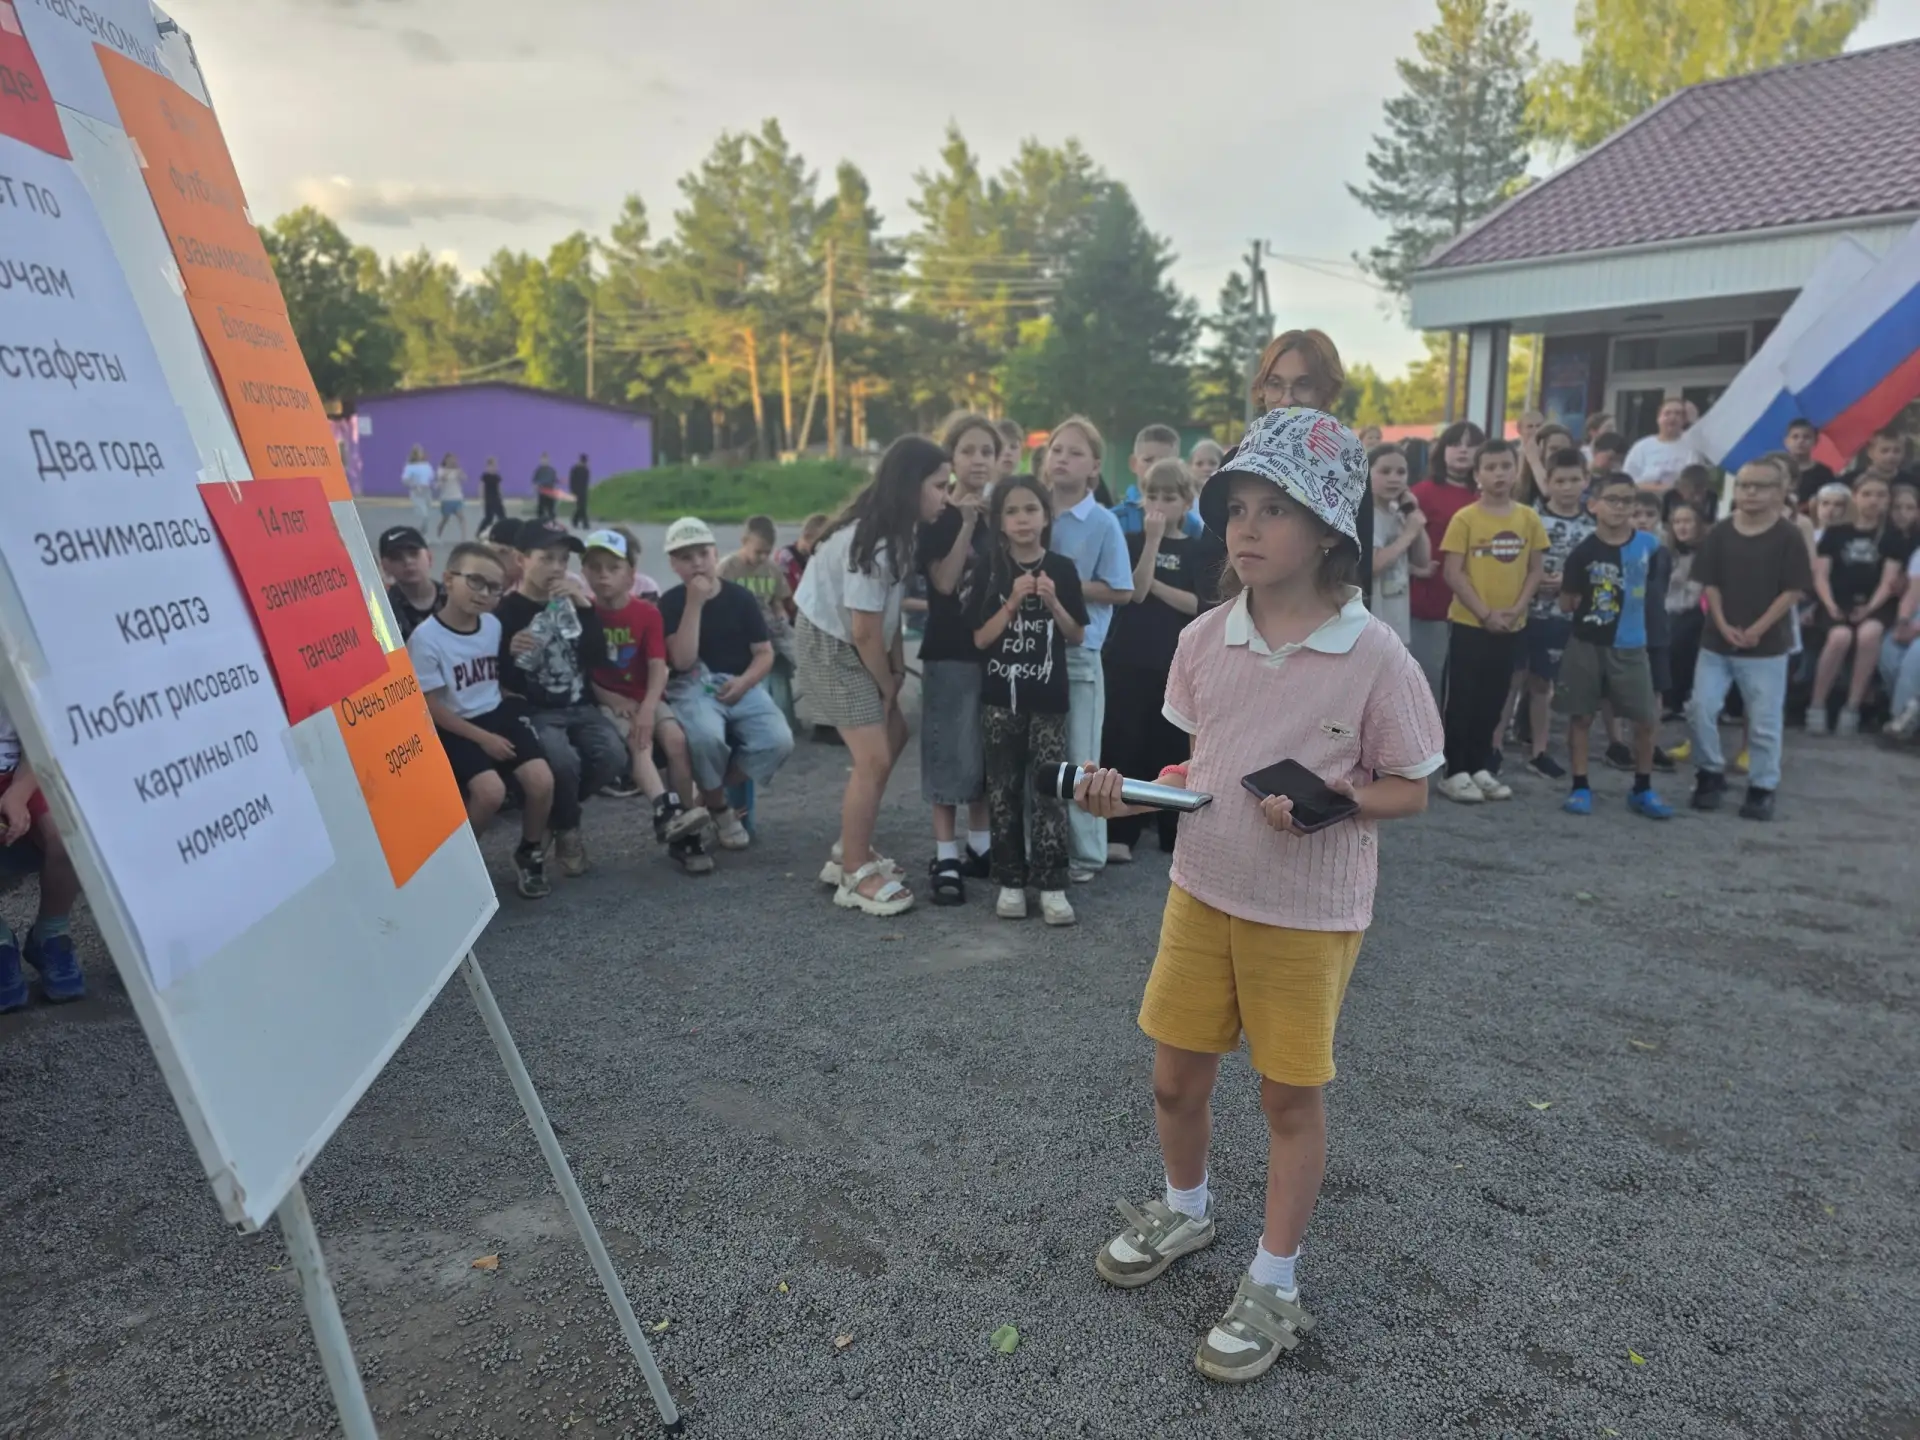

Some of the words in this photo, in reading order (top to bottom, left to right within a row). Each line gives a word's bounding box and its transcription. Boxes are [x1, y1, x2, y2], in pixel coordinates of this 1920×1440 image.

[22, 181, 61, 219] по
[29, 429, 98, 482] Два
[98, 439, 165, 478] года
[266, 444, 306, 468] спать
[305, 445, 331, 467] стоя
[34, 517, 212, 566] занималась
[257, 505, 282, 538] 14
[282, 509, 309, 535] лет
[261, 565, 348, 611] занималась
[115, 595, 211, 645] каратэ
[298, 625, 360, 671] танцами
[1002, 636, 1036, 653] FOR
[66, 690, 162, 746] Любит
[166, 661, 260, 711] рисовать
[341, 691, 385, 727] Очень
[382, 674, 417, 707] плохое
[133, 739, 235, 803] картины
[233, 729, 260, 758] по
[385, 733, 423, 778] зрение
[176, 792, 274, 865] номерам
